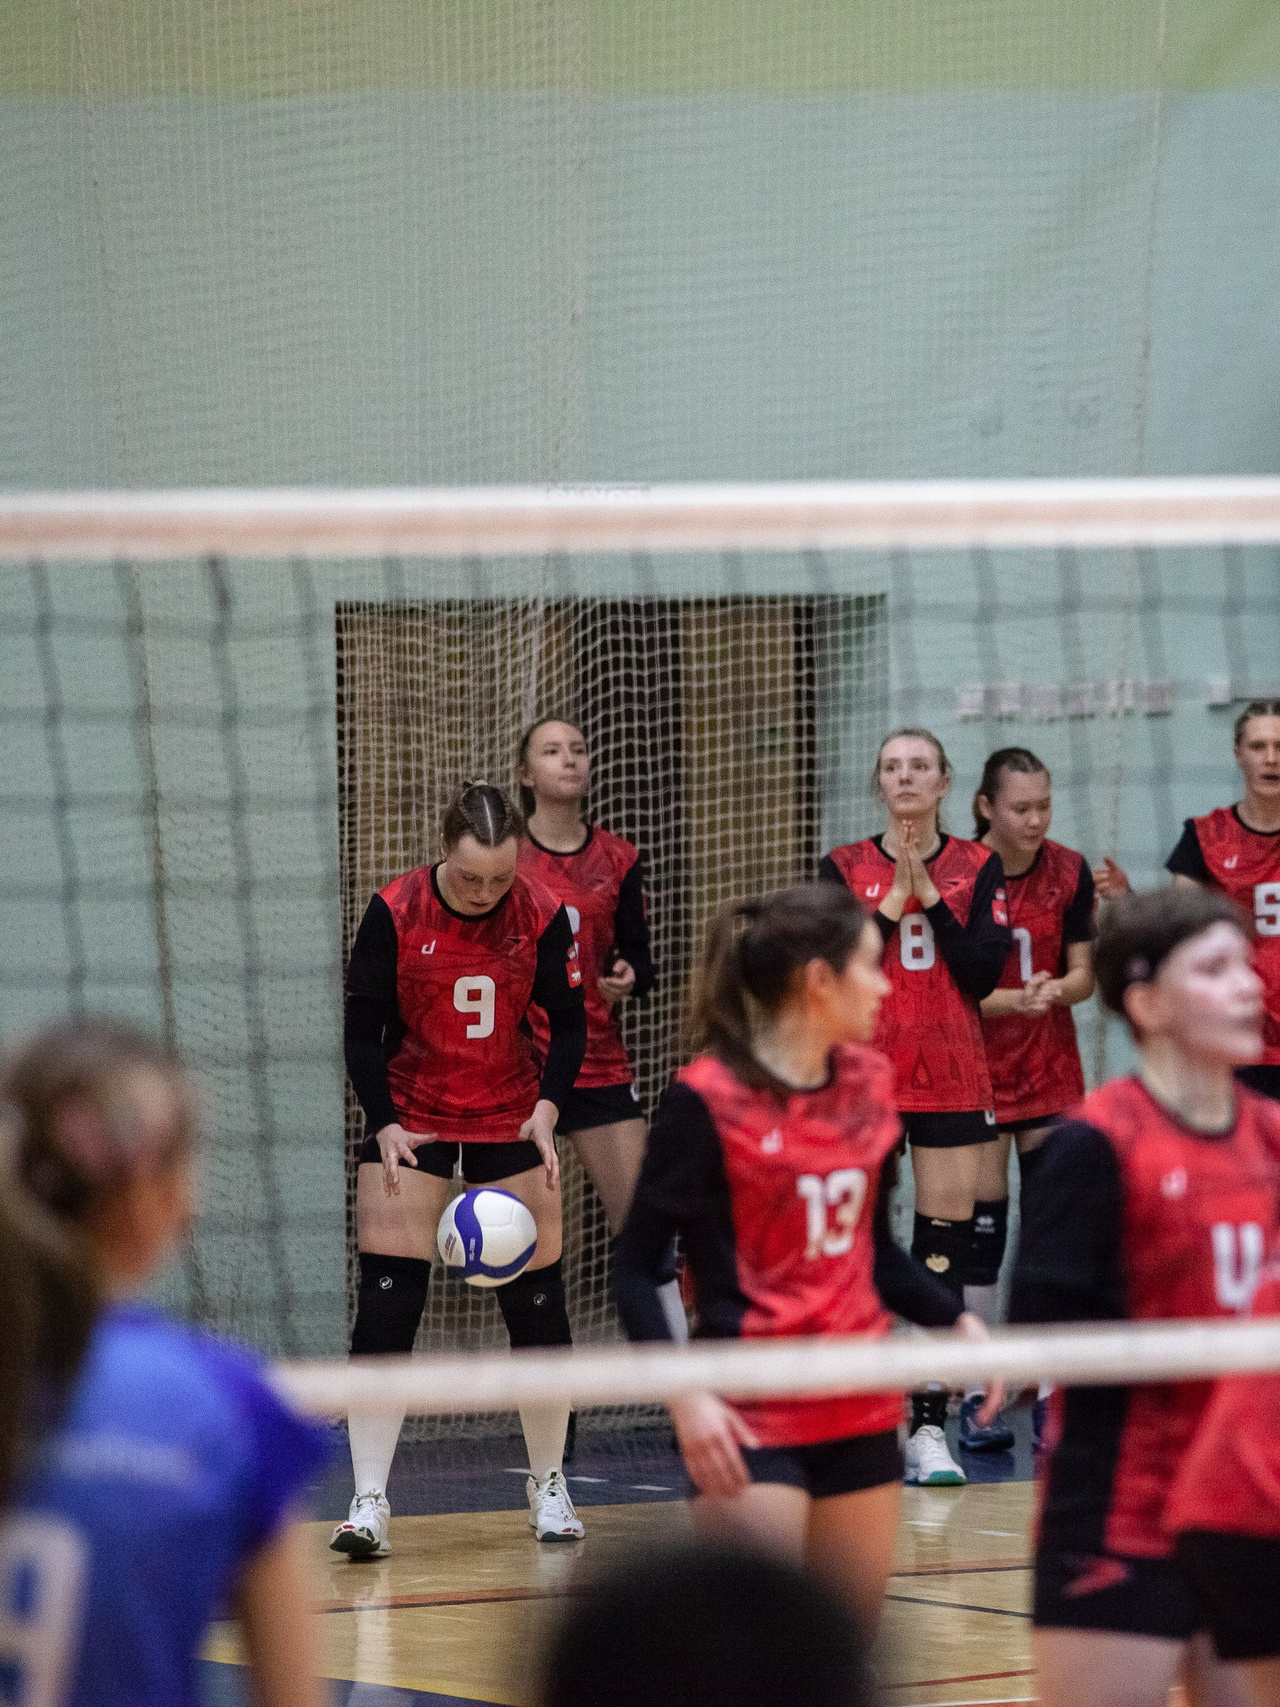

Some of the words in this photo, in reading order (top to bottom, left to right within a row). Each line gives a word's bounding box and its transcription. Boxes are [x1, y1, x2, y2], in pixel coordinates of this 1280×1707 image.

[900, 913, 935, 971] 8
[453, 975, 496, 1039] 9
[797, 1168, 867, 1260] 13
